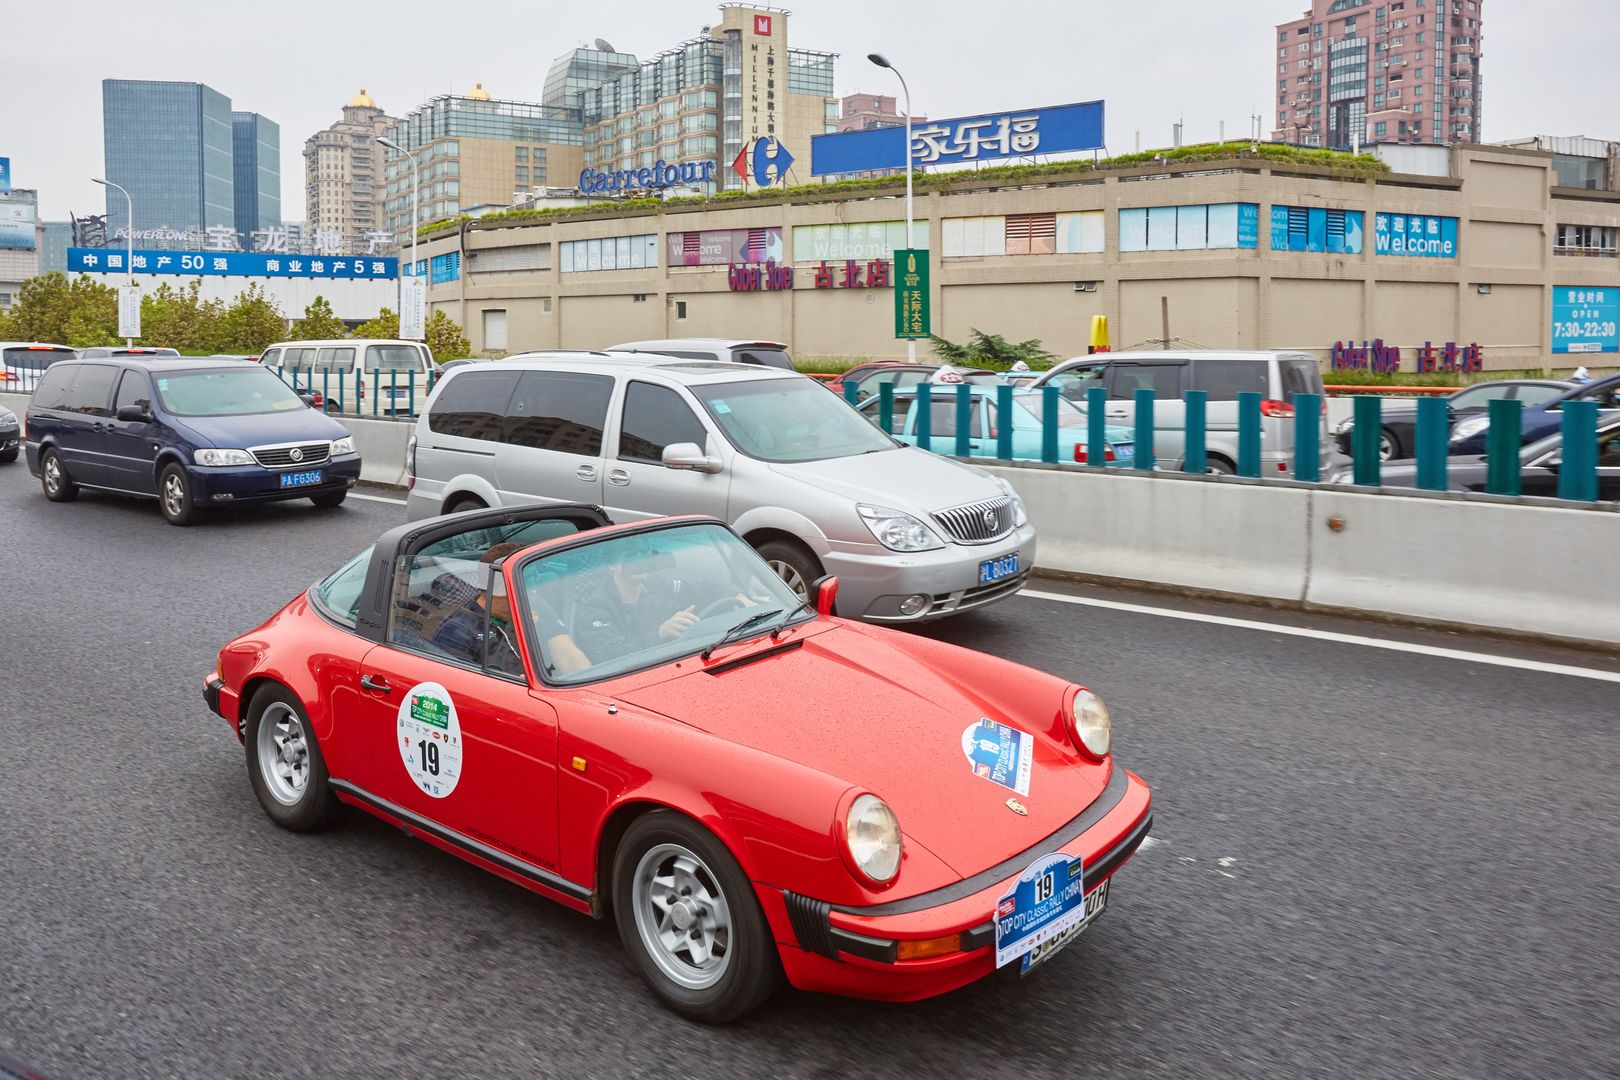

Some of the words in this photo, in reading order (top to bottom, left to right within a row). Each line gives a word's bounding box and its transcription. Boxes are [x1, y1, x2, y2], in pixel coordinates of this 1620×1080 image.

[911, 115, 1041, 162] 家乐福
[579, 159, 715, 194] Carrefour
[1375, 215, 1439, 234] 欢迎光临
[814, 241, 893, 257] Welcome
[1375, 232, 1453, 254] Welcome
[83, 254, 228, 271] 中国地产50强
[266, 259, 386, 275] 商业地产5强
[576, 254, 640, 269] Welcome
[728, 262, 762, 291] Gubei
[811, 258, 890, 289] 古北店
[1567, 291, 1604, 304] 营业时间
[1572, 309, 1600, 319] OPEN
[1554, 321, 1616, 337] 7:30-22:30
[422, 699, 438, 713] 2014
[418, 739, 440, 777] 19
[1036, 873, 1052, 902] 19
[1000, 917, 1013, 935] TOP
[1014, 912, 1027, 929] CITY
[1027, 901, 1049, 923] CLASSIC
